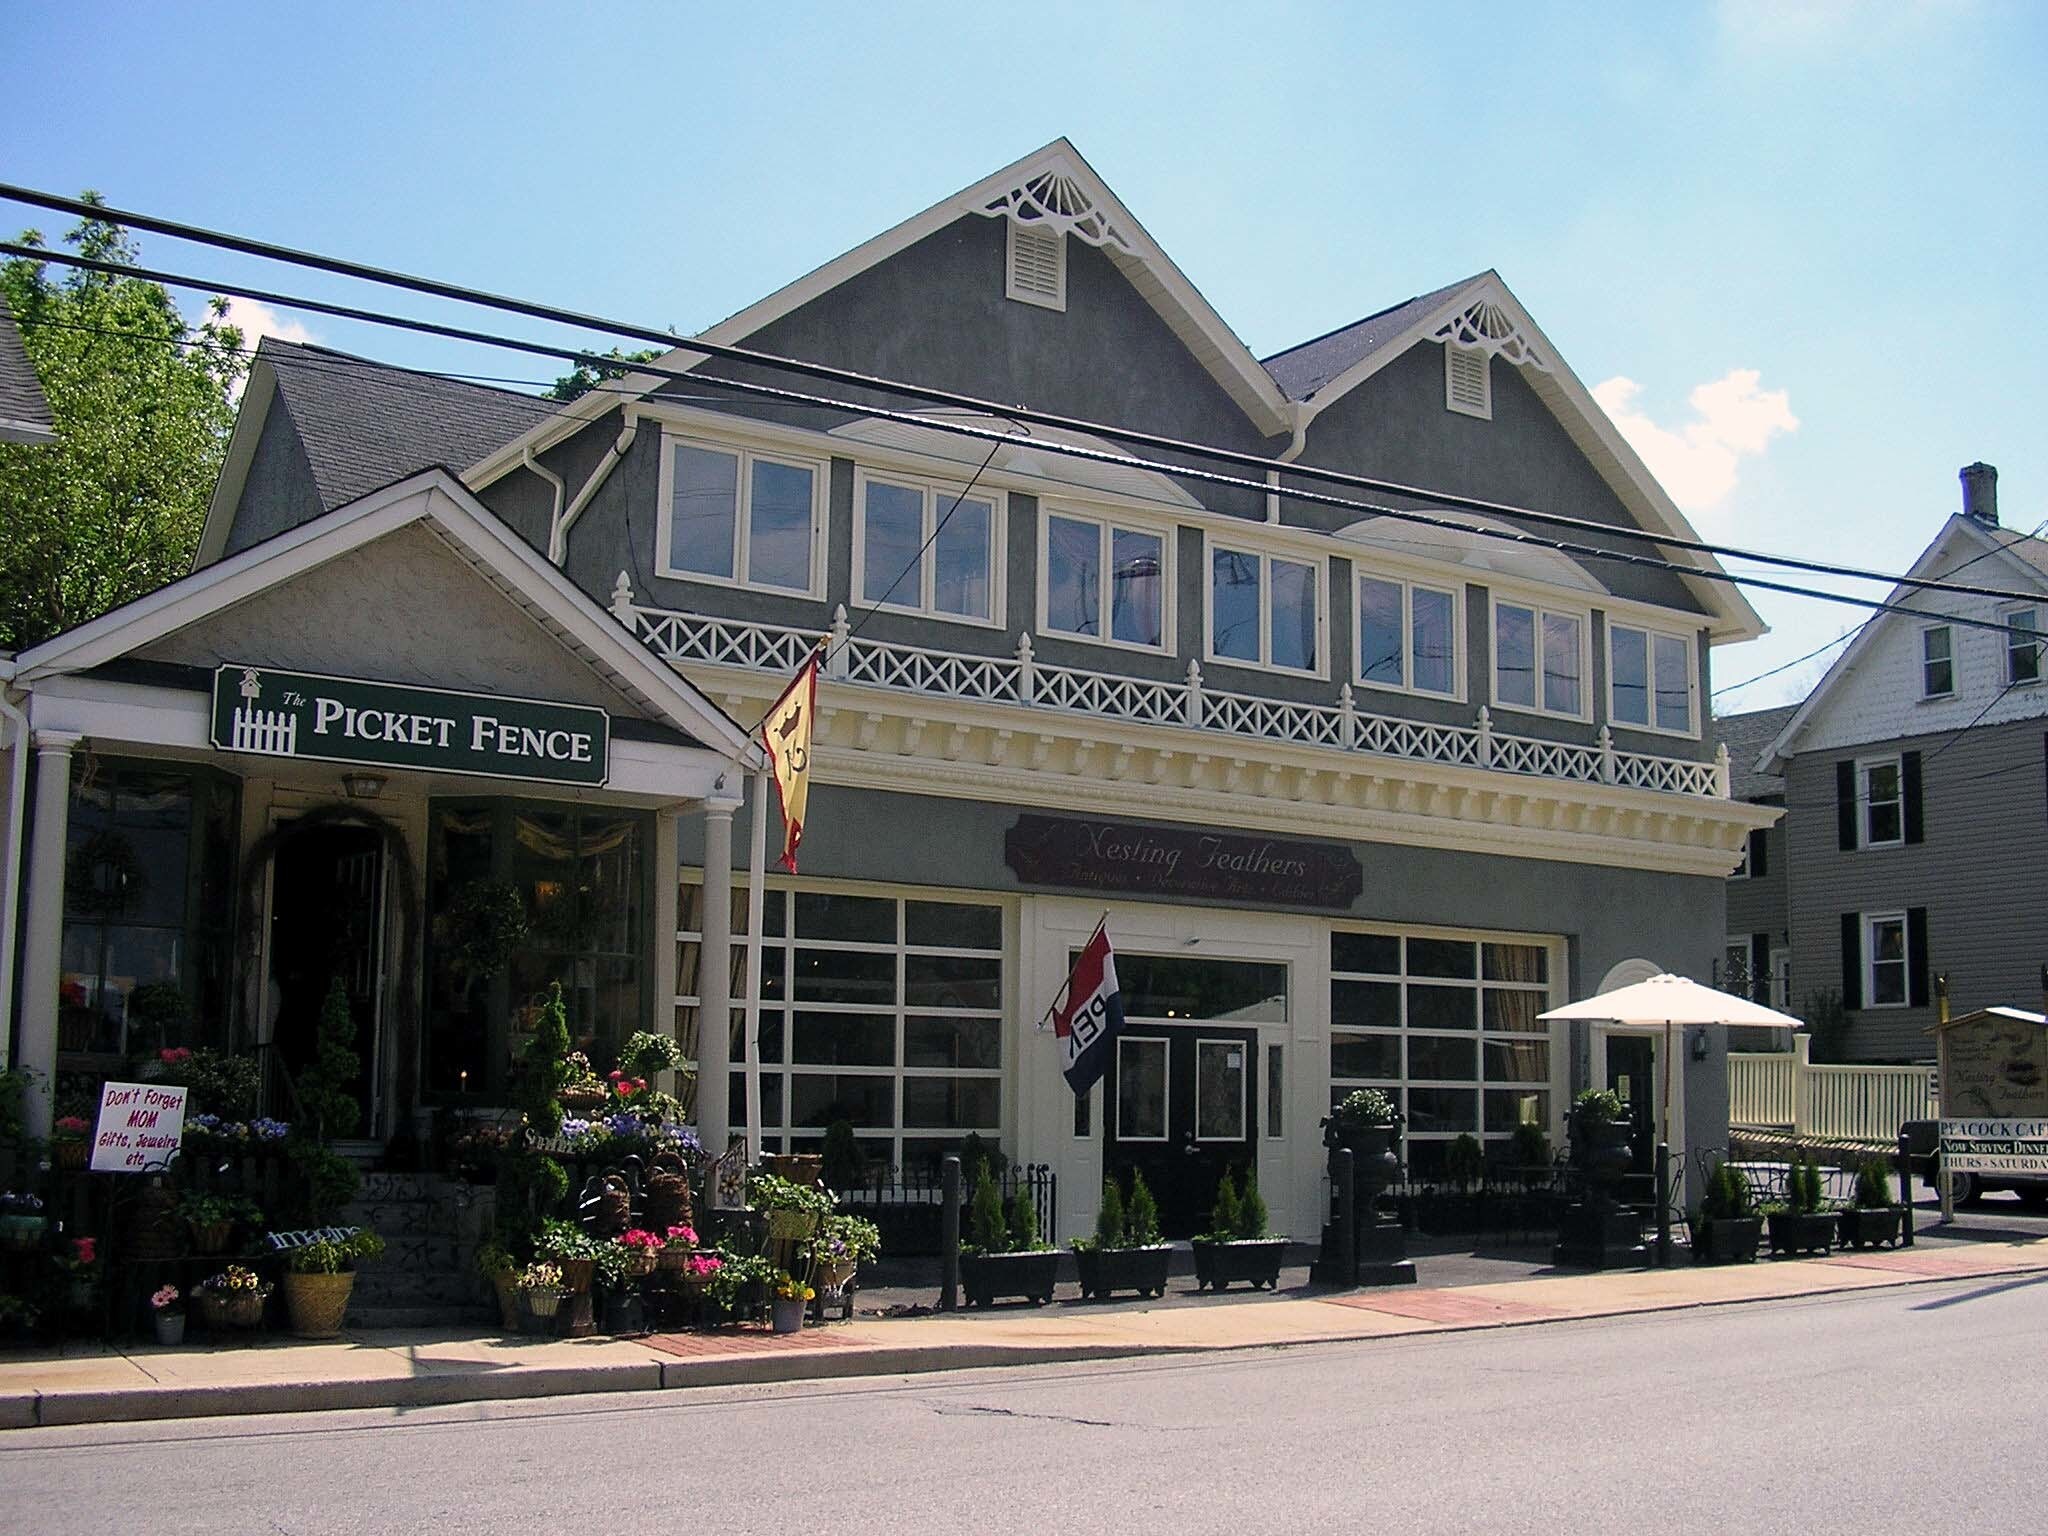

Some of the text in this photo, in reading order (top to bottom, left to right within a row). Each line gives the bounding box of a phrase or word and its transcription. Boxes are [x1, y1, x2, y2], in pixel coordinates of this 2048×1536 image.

[283, 692, 592, 762] The PICKET FENCE
[1080, 824, 1306, 877] Nesting Feathers
[105, 1088, 183, 1110] Don't Forget
[126, 1110, 159, 1129] MOM
[1940, 1122, 2048, 1136] PEACOCK CAF
[1969, 1141, 2011, 1154] SERVING
[1990, 1158, 2048, 1169] SATURDA
